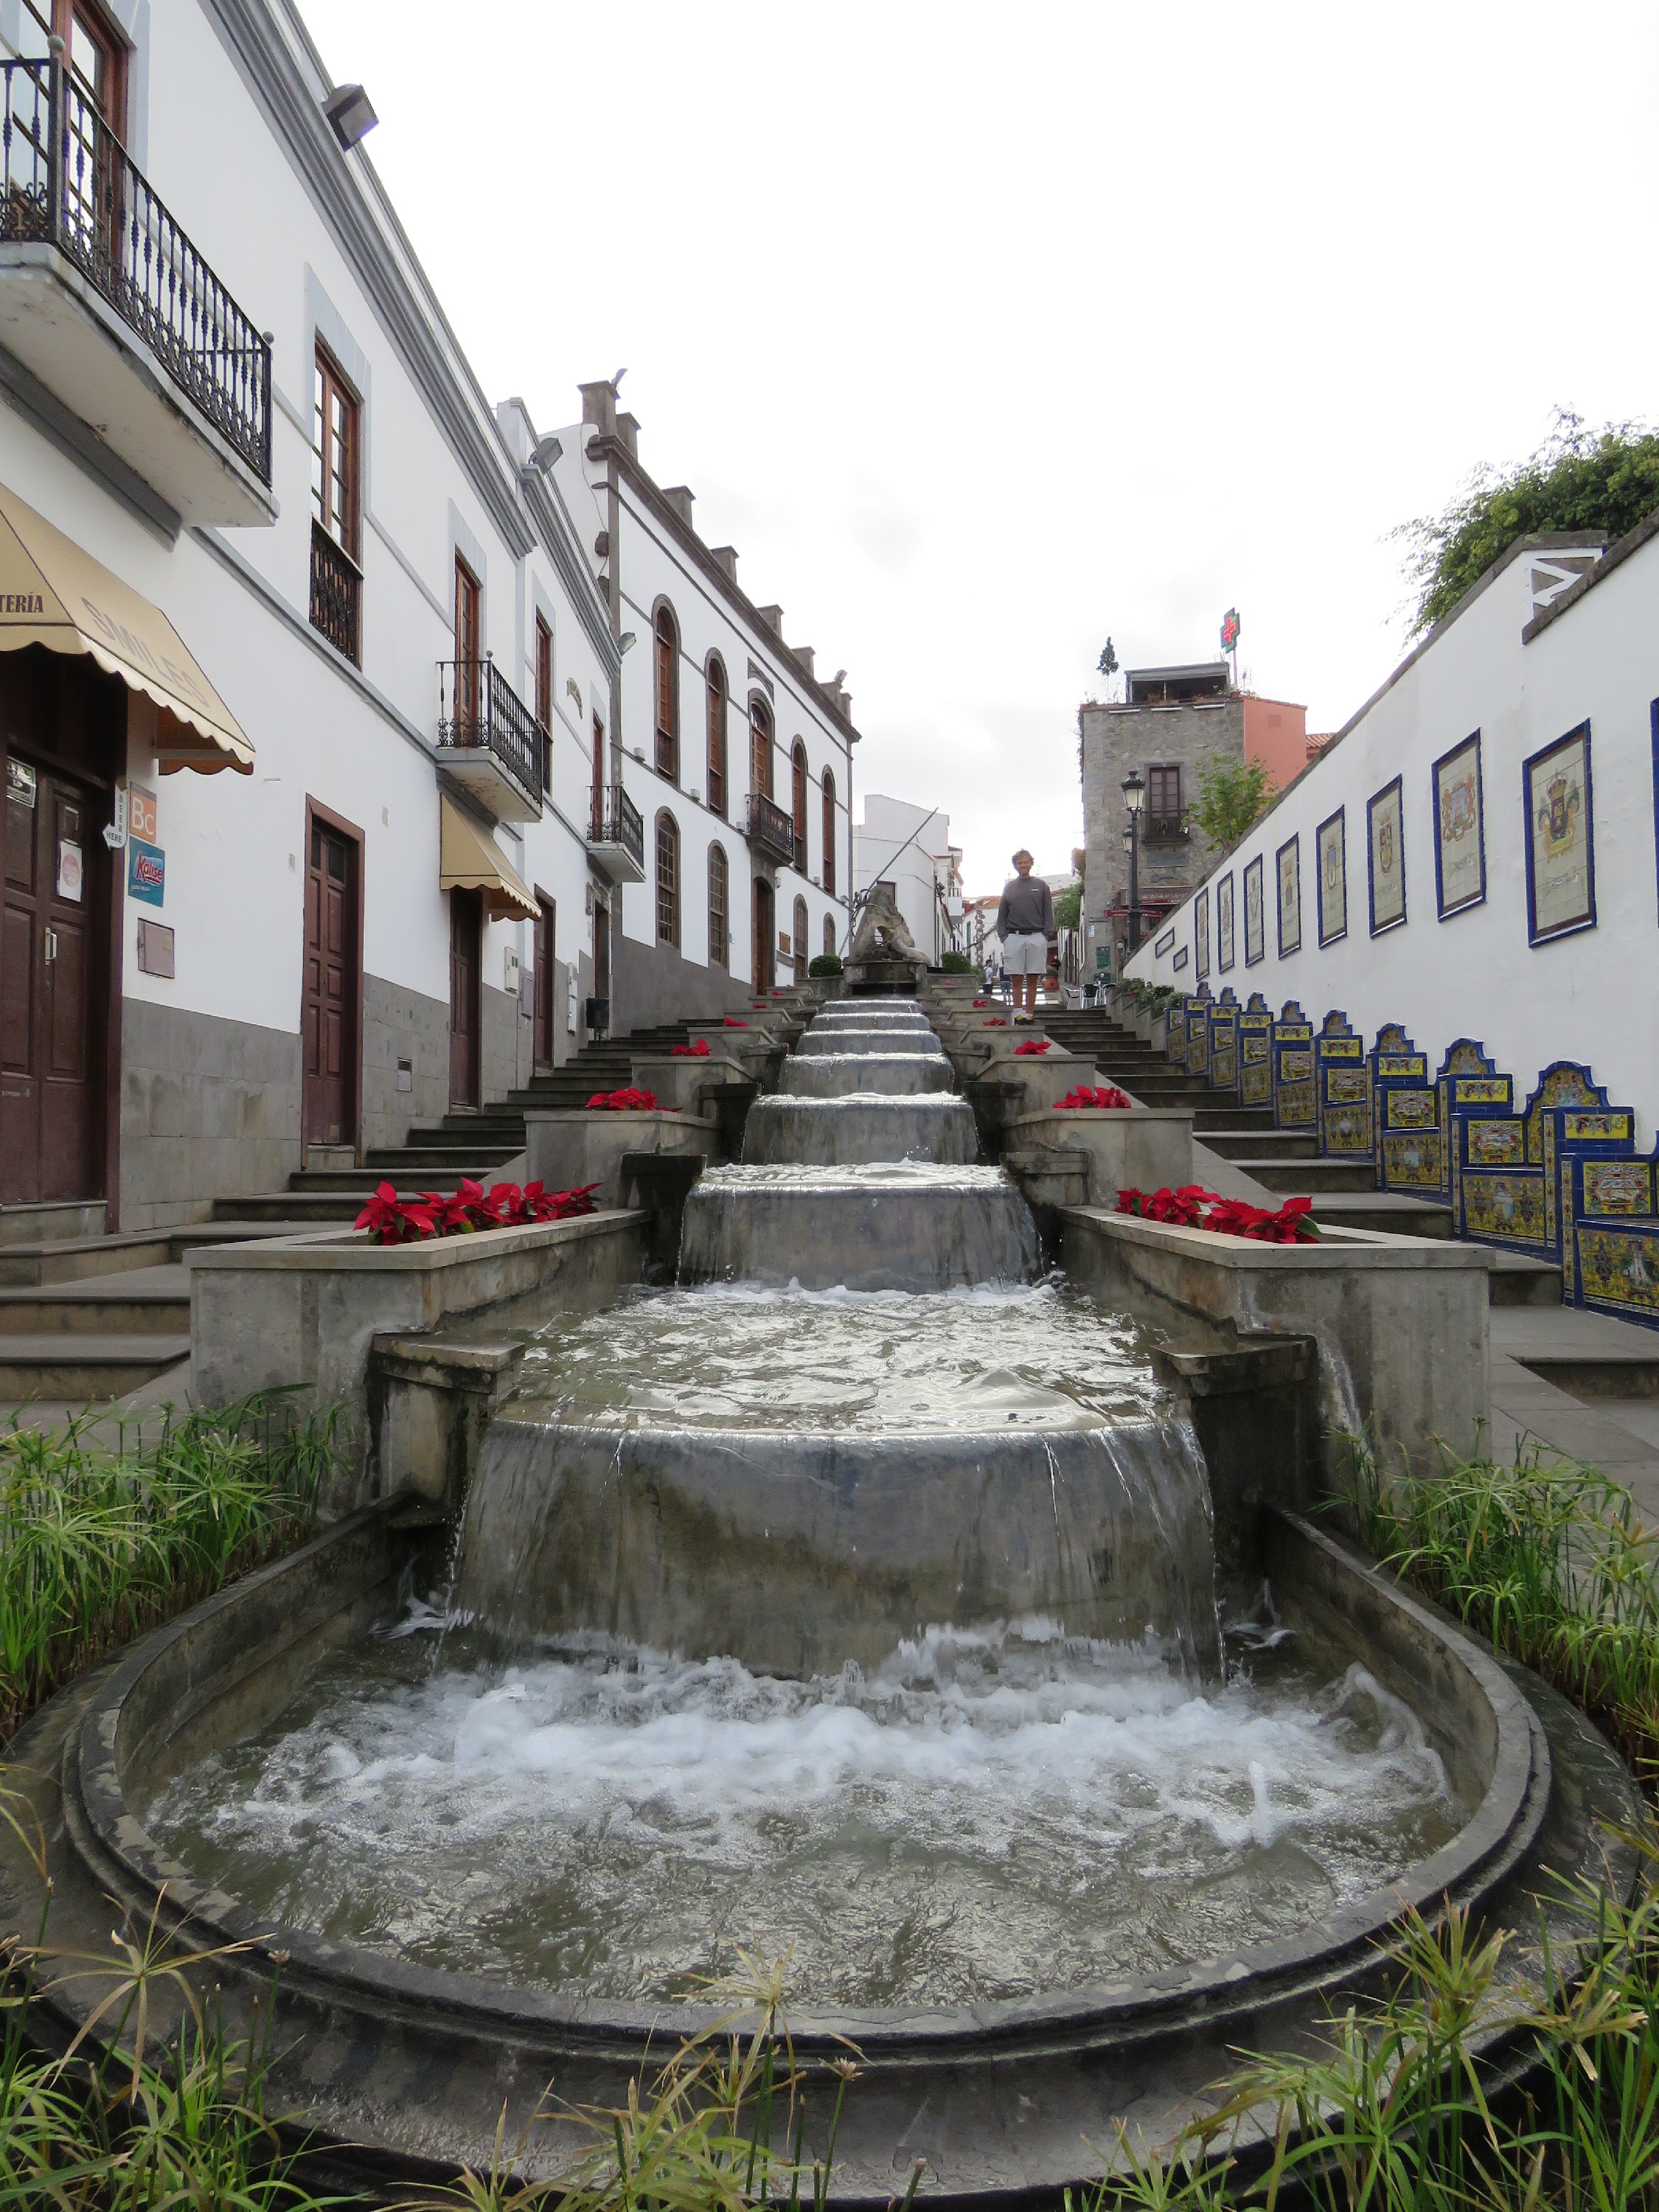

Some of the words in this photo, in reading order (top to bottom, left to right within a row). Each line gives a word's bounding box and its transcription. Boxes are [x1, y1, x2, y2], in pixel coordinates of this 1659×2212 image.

[80, 597, 210, 709] SMILES
[106, 830, 122, 844] HERE
[136, 852, 163, 883] Kalise
